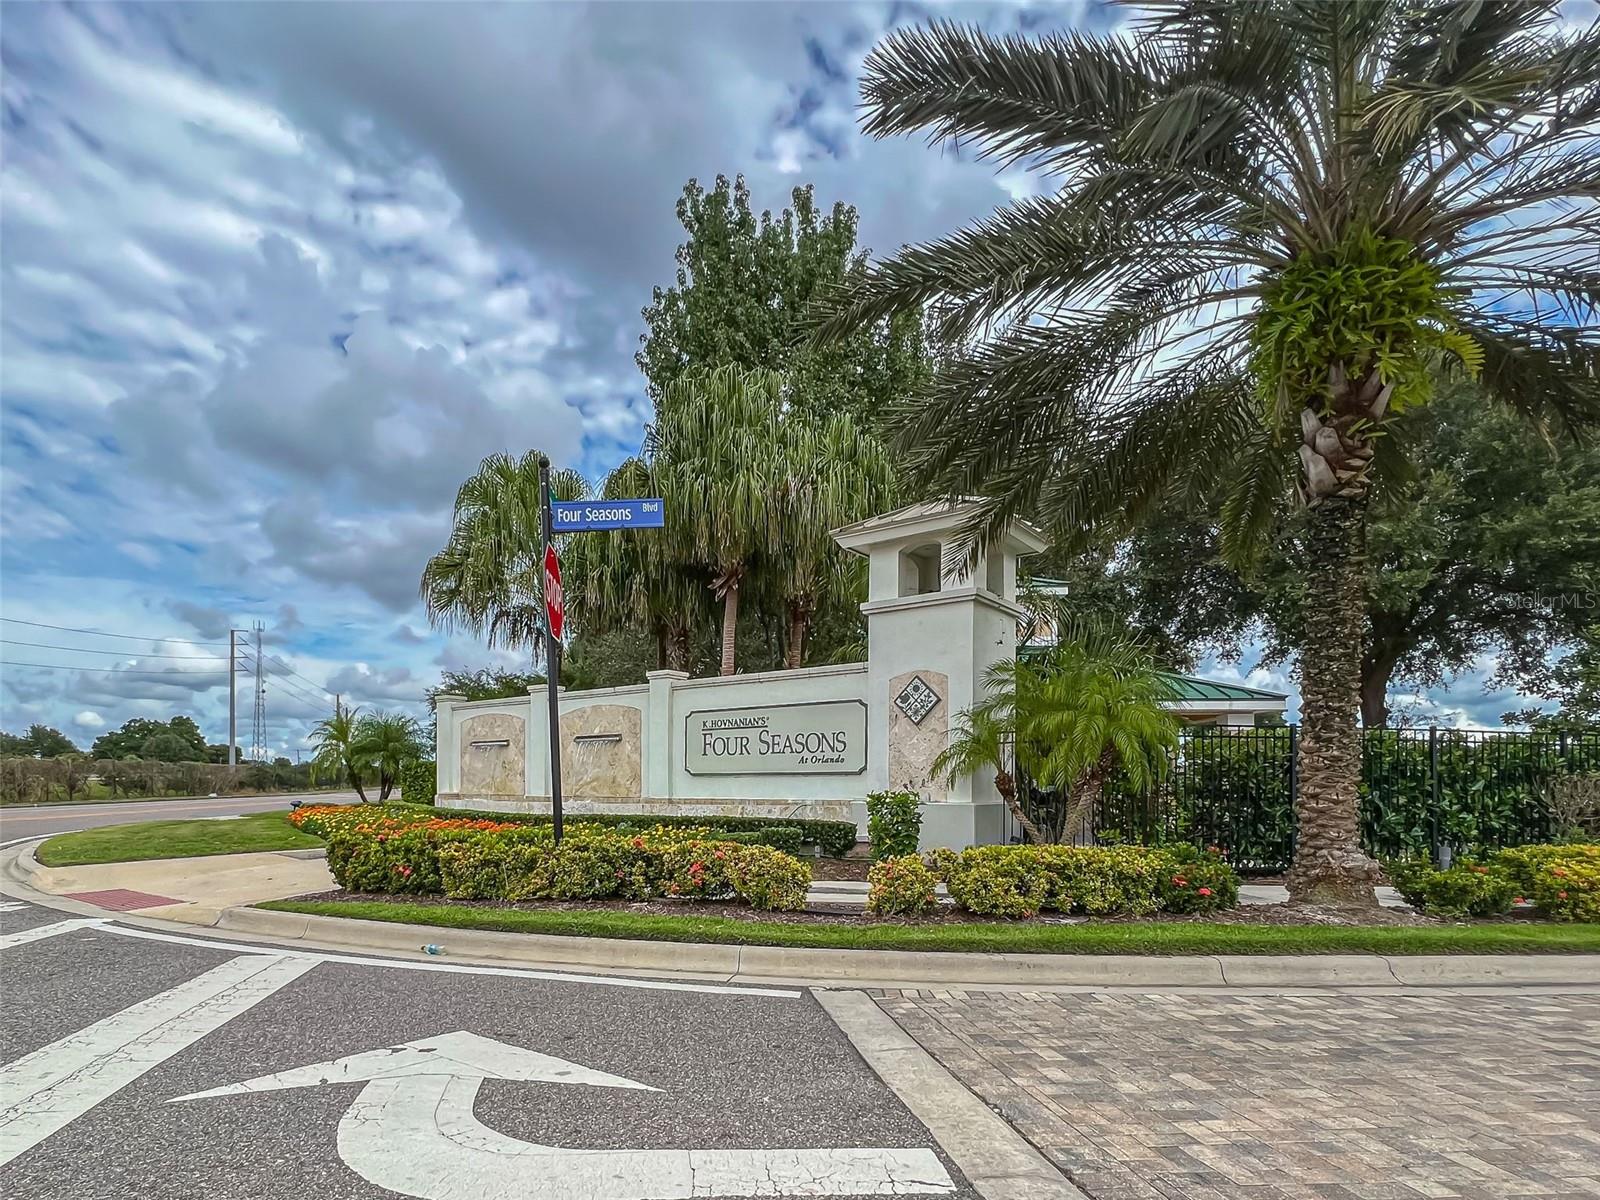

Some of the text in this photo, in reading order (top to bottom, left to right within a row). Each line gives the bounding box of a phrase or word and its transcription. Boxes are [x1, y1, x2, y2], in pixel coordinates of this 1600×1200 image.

[557, 502, 658, 522] Four Seasons Blvd
[545, 569, 562, 614] STOP
[702, 729, 847, 756] FOUR SEASONS
[798, 754, 845, 764] At Orlando
